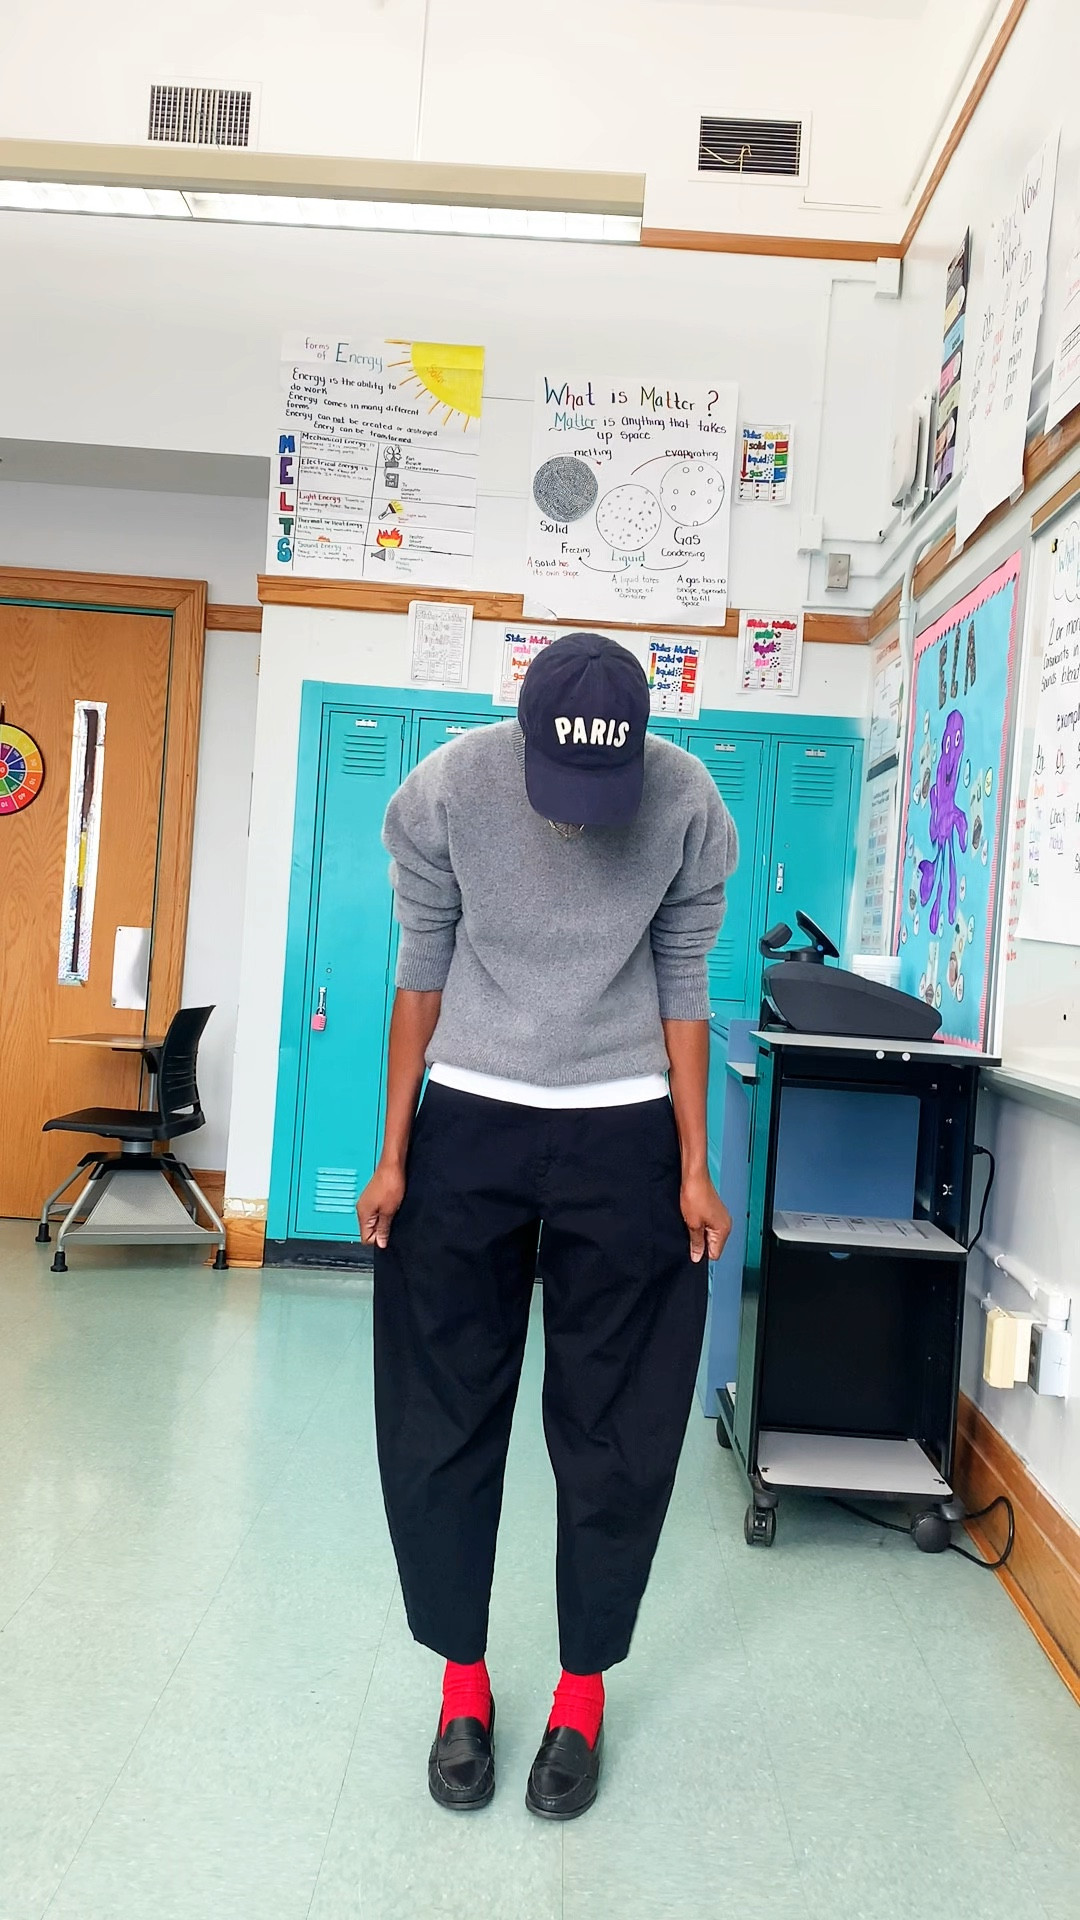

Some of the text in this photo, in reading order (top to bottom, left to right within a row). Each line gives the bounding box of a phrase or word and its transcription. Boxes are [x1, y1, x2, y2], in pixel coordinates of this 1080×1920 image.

[316, 350, 326, 360] of
[335, 342, 383, 374] Energy
[292, 366, 326, 387] Energy
[329, 377, 339, 385] is
[341, 377, 356, 386] the
[356, 380, 384, 395] ability
[290, 382, 328, 395] do work
[544, 377, 595, 410] What
[611, 388, 628, 404] is
[641, 386, 695, 412] Matter
[286, 399, 310, 410] forms
[288, 391, 318, 405] Energy
[323, 398, 348, 408] comes
[361, 404, 383, 414] many
[385, 405, 419, 416] different
[285, 408, 313, 421] Energy
[317, 413, 331, 421] can
[349, 417, 359, 425] be
[362, 421, 393, 431] created
[406, 427, 438, 437] destroyed
[555, 412, 727, 434] Matter is anything that takes
[302, 432, 342, 444] Mechanical
[344, 439, 367, 448] Energy
[596, 431, 613, 445] up
[749, 441, 766, 450] solid
[574, 448, 612, 460] melting
[748, 454, 766, 466] liquid
[301, 458, 336, 467] Electrical
[338, 463, 359, 471] Energy
[749, 470, 764, 478] gas
[299, 491, 316, 502] Light
[318, 494, 341, 504] Energy
[540, 520, 568, 534] Solid
[673, 526, 701, 546] Gas
[297, 541, 319, 549] Sound
[561, 541, 591, 558] Freezing
[611, 549, 646, 566] Liquid
[661, 548, 706, 562] Condensing
[527, 556, 533, 568] A
[558, 559, 569, 568] has
[562, 570, 580, 579] shape
[611, 574, 618, 584] A
[620, 575, 640, 586] liquid
[676, 574, 684, 584] A
[685, 577, 700, 588] gas
[702, 575, 716, 584] has
[505, 634, 526, 642] States
[1048, 617, 1080, 646] 2 or mor
[650, 643, 699, 655] States Matter
[658, 654, 675, 663] solid
[939, 619, 976, 709] ELA
[656, 667, 675, 678] liquid
[657, 682, 671, 690] gas
[554, 715, 631, 748] PARIS
